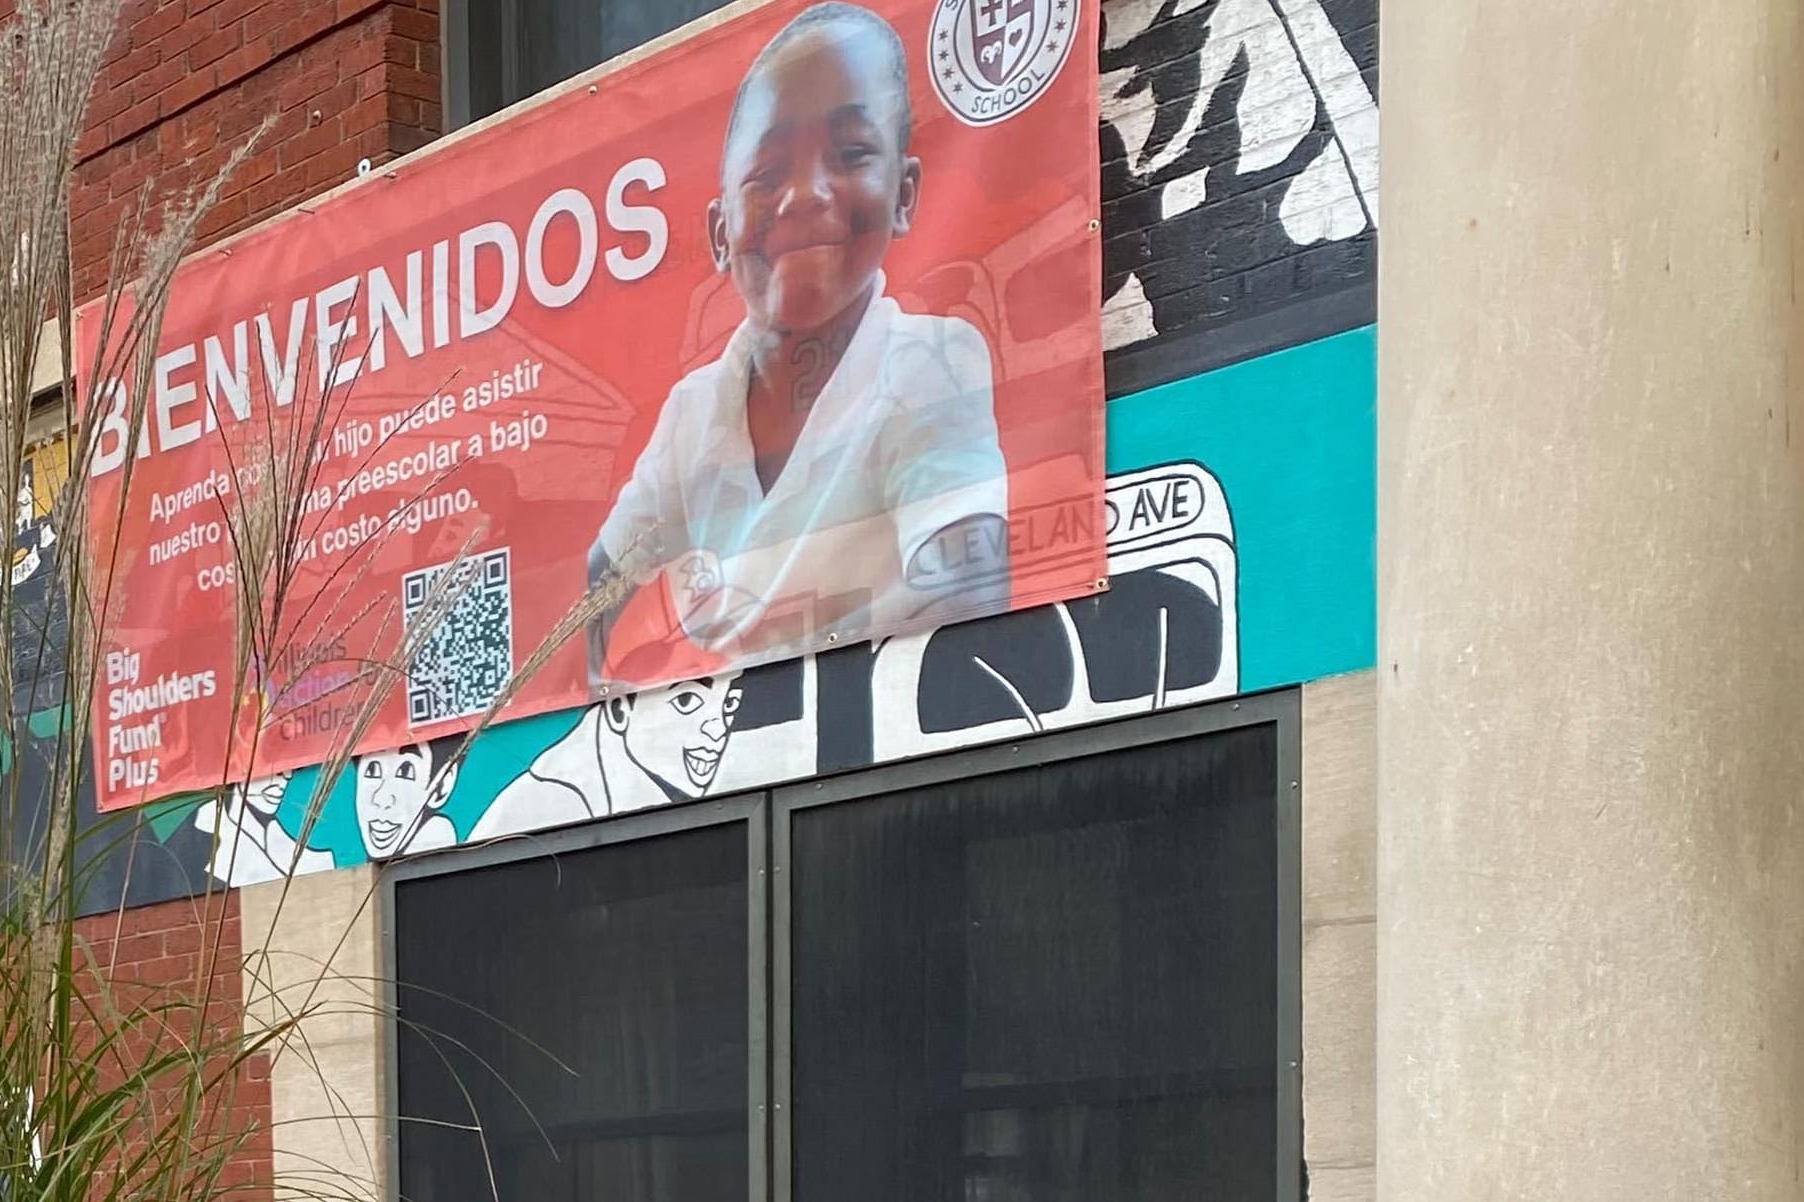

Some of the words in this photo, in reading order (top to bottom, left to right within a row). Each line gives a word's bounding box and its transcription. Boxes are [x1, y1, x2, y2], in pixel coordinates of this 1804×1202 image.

[972, 69, 1045, 114] SCHOOL
[149, 470, 230, 524] Aprenda
[334, 419, 373, 458] hijo
[380, 394, 457, 444] puede
[462, 359, 544, 413] asistir
[149, 521, 221, 566] nuestro
[337, 440, 461, 511] preescolar
[467, 433, 483, 457] a
[490, 410, 548, 452] bajo
[1129, 480, 1190, 531] AVE
[198, 561, 237, 592] cos
[322, 509, 382, 551] costo
[387, 487, 479, 535] alguno.
[107, 648, 141, 686] Big
[108, 669, 216, 721] Shoulders
[108, 755, 159, 793] Plus
